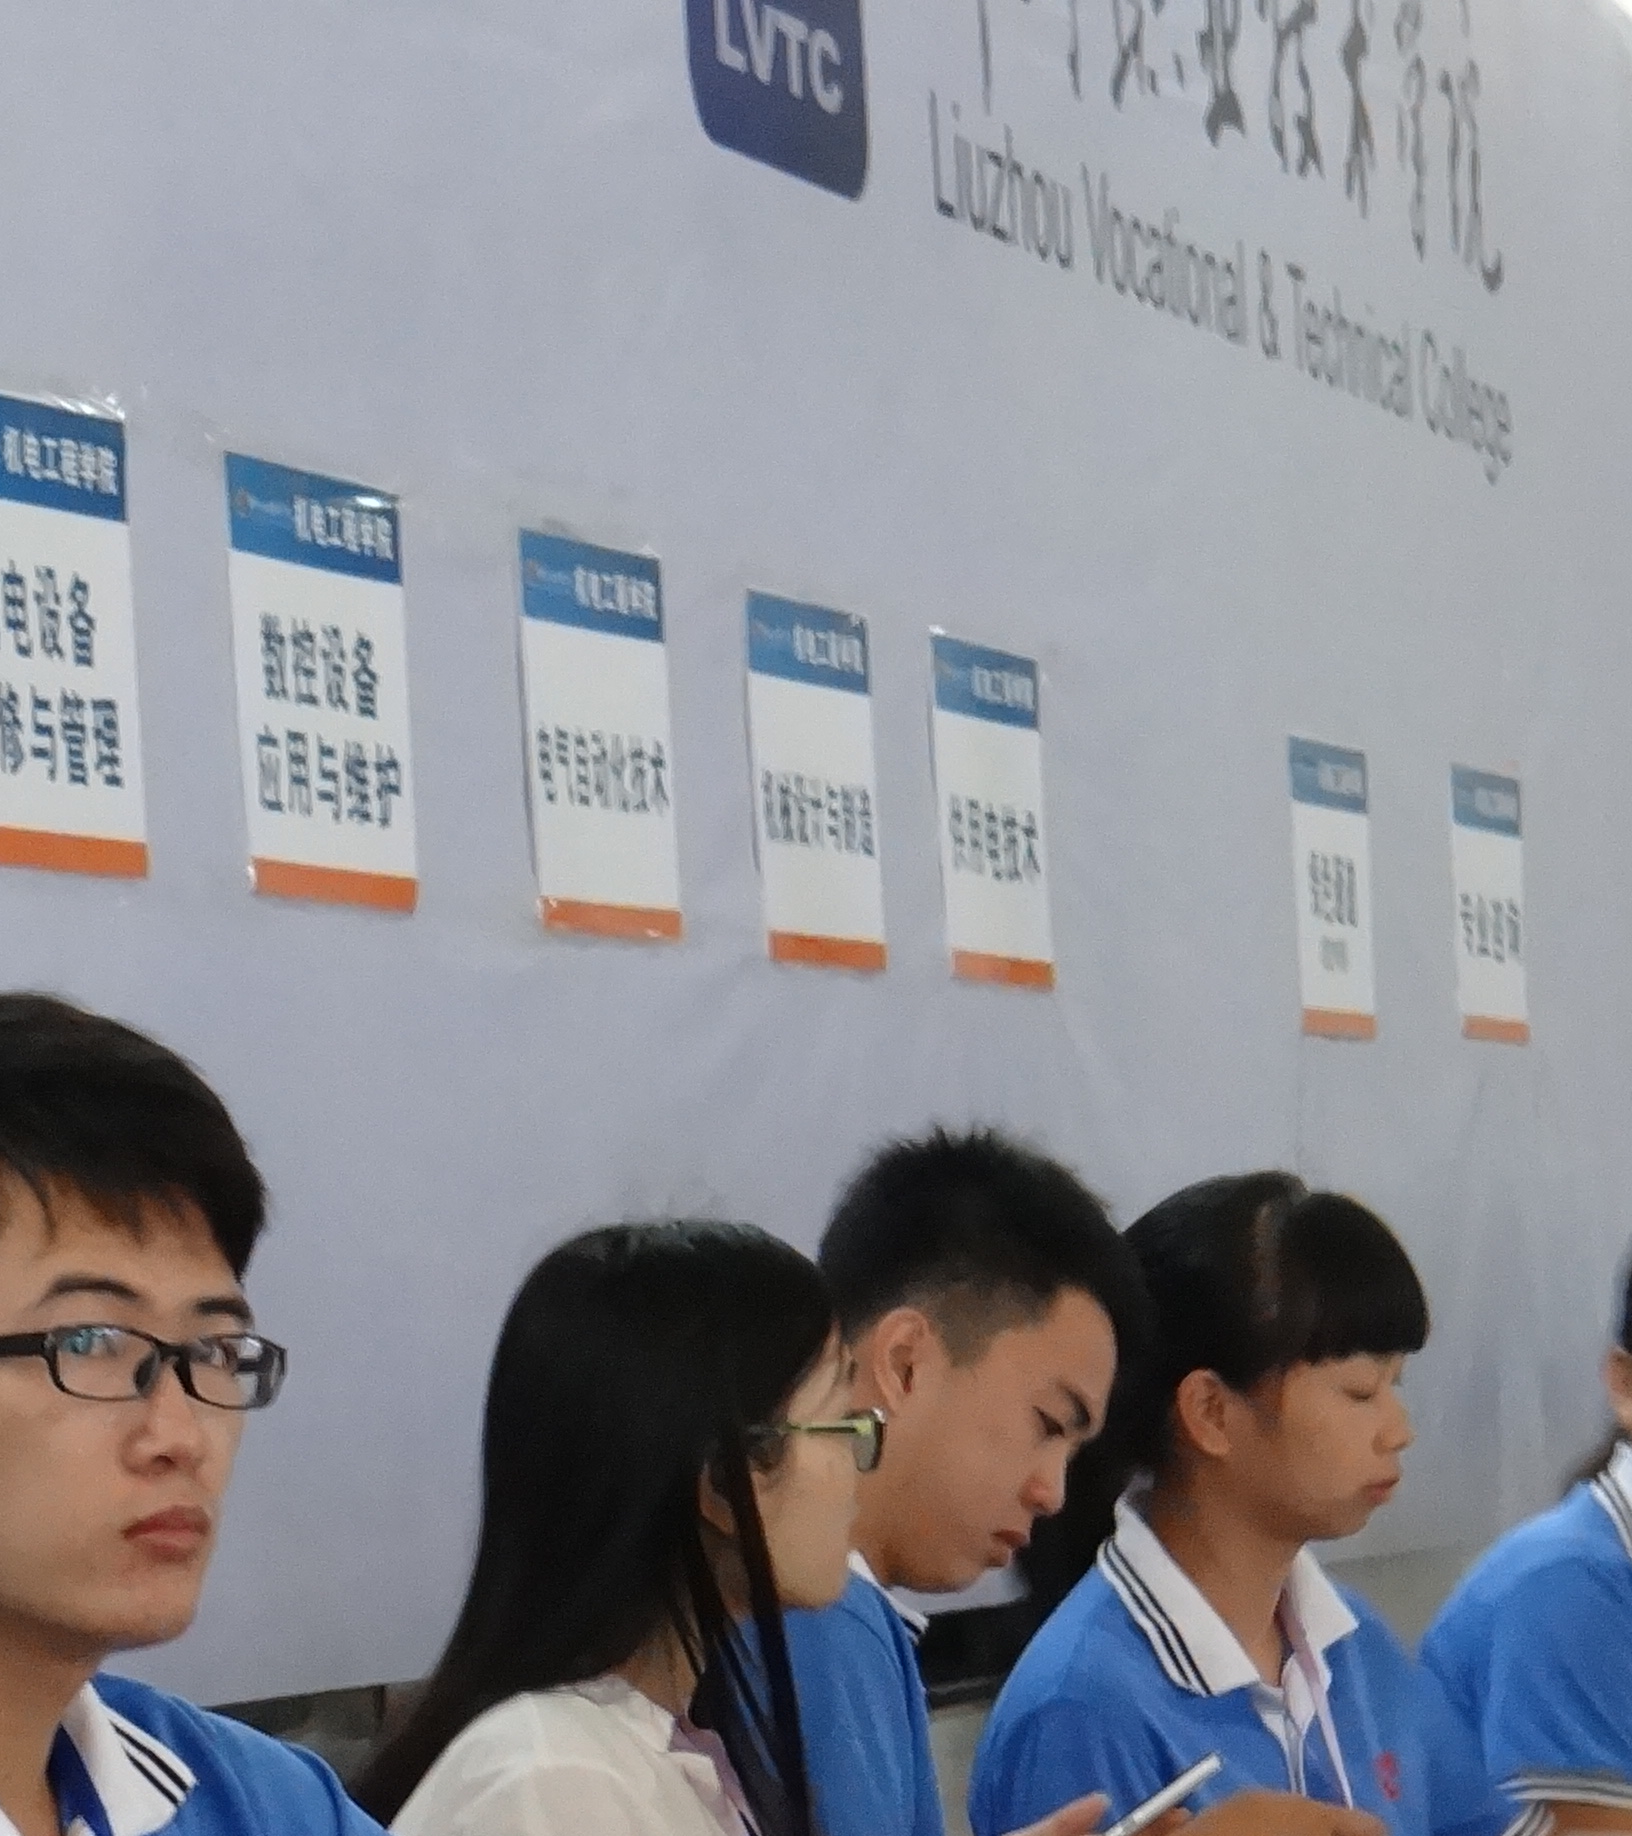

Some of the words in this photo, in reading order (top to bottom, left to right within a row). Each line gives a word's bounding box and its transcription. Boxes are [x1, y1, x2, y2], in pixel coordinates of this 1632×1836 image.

[713, 0, 844, 115] LVTC
[928, 87, 1074, 270] Liuzhou
[1079, 160, 1247, 350] Vocational
[1258, 246, 1282, 361] &
[1285, 262, 1413, 422] Technical
[1420, 325, 1514, 487] College
[260, 612, 379, 720] 数控设备
[256, 724, 402, 829] 应用与维护
